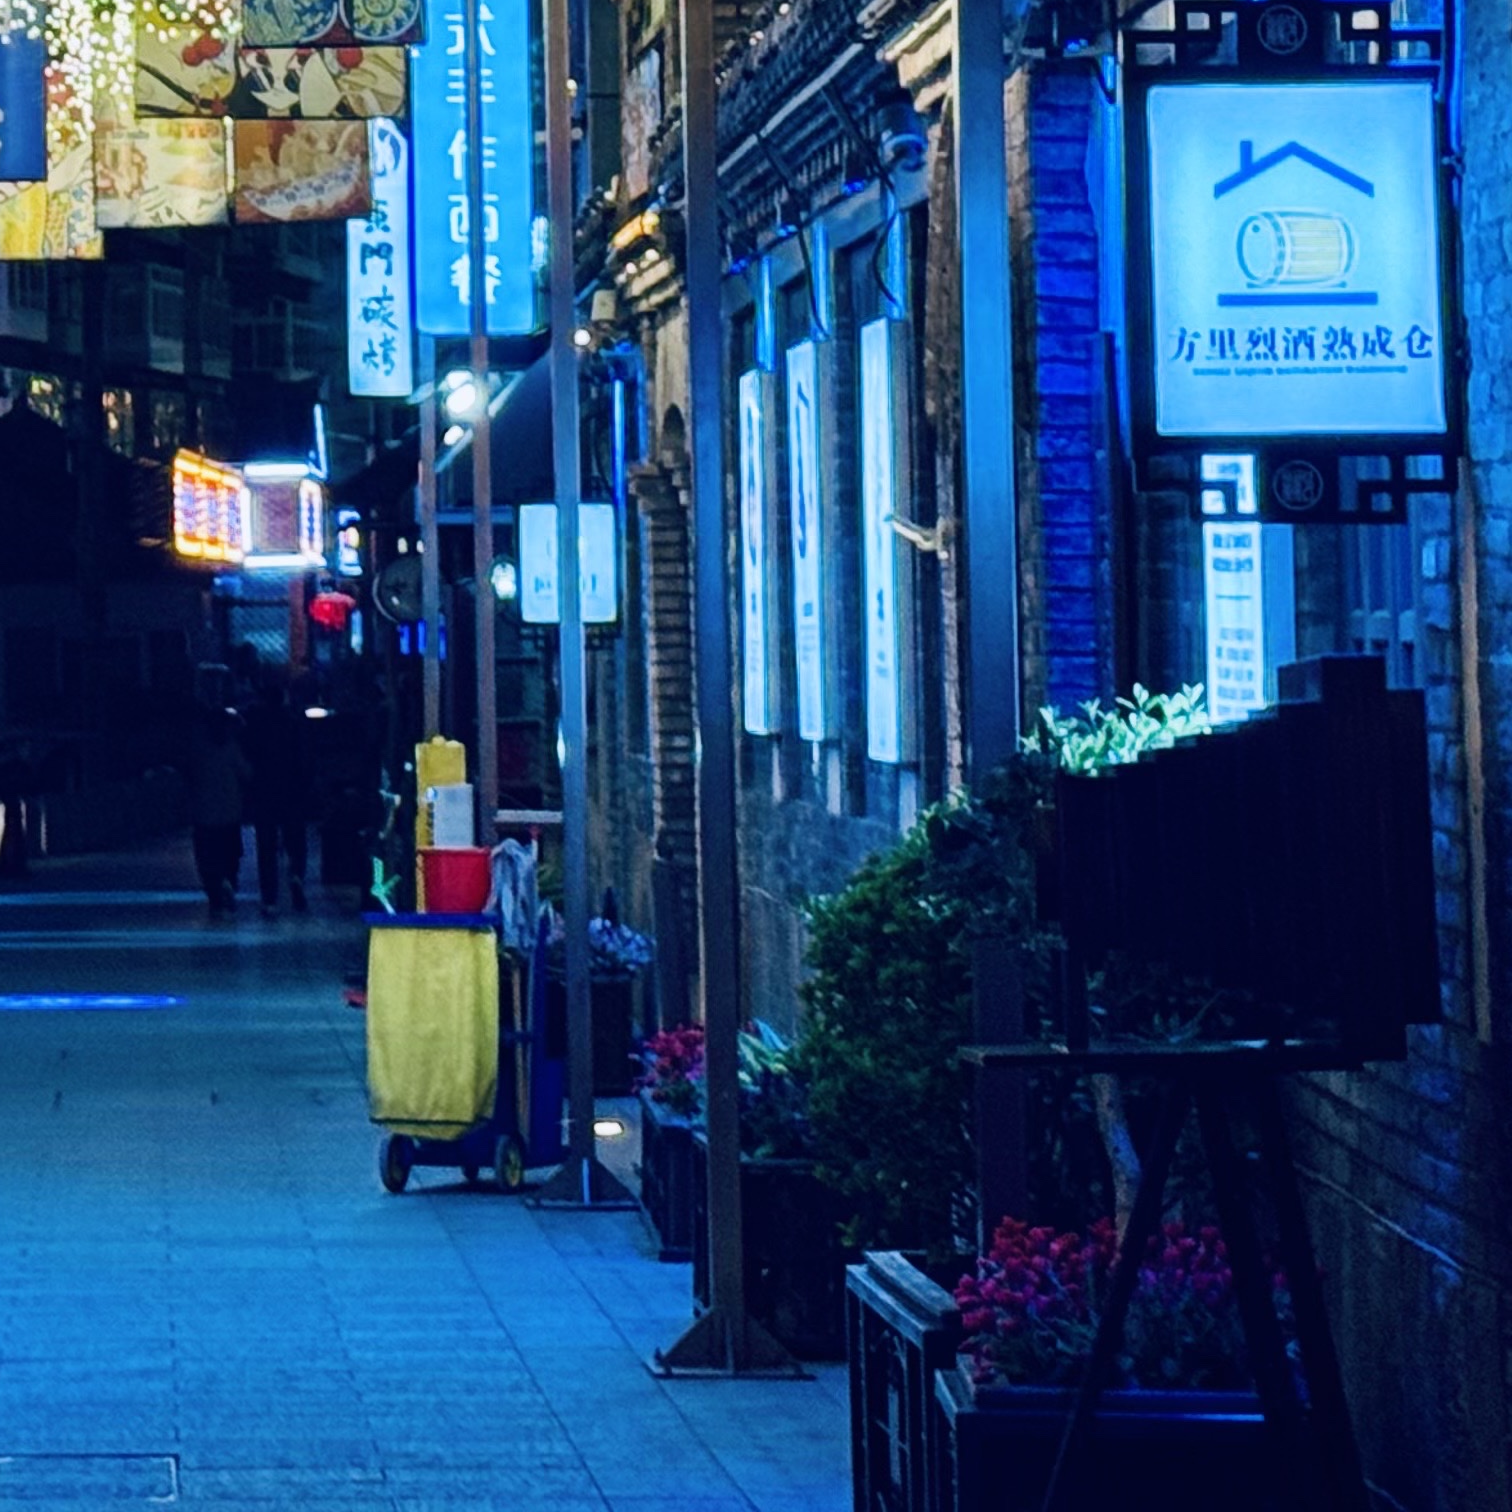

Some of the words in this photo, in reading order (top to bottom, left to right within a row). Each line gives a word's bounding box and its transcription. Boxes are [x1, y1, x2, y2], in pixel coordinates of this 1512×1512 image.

[1168, 324, 1434, 363] 方里烈酒熟成仓
